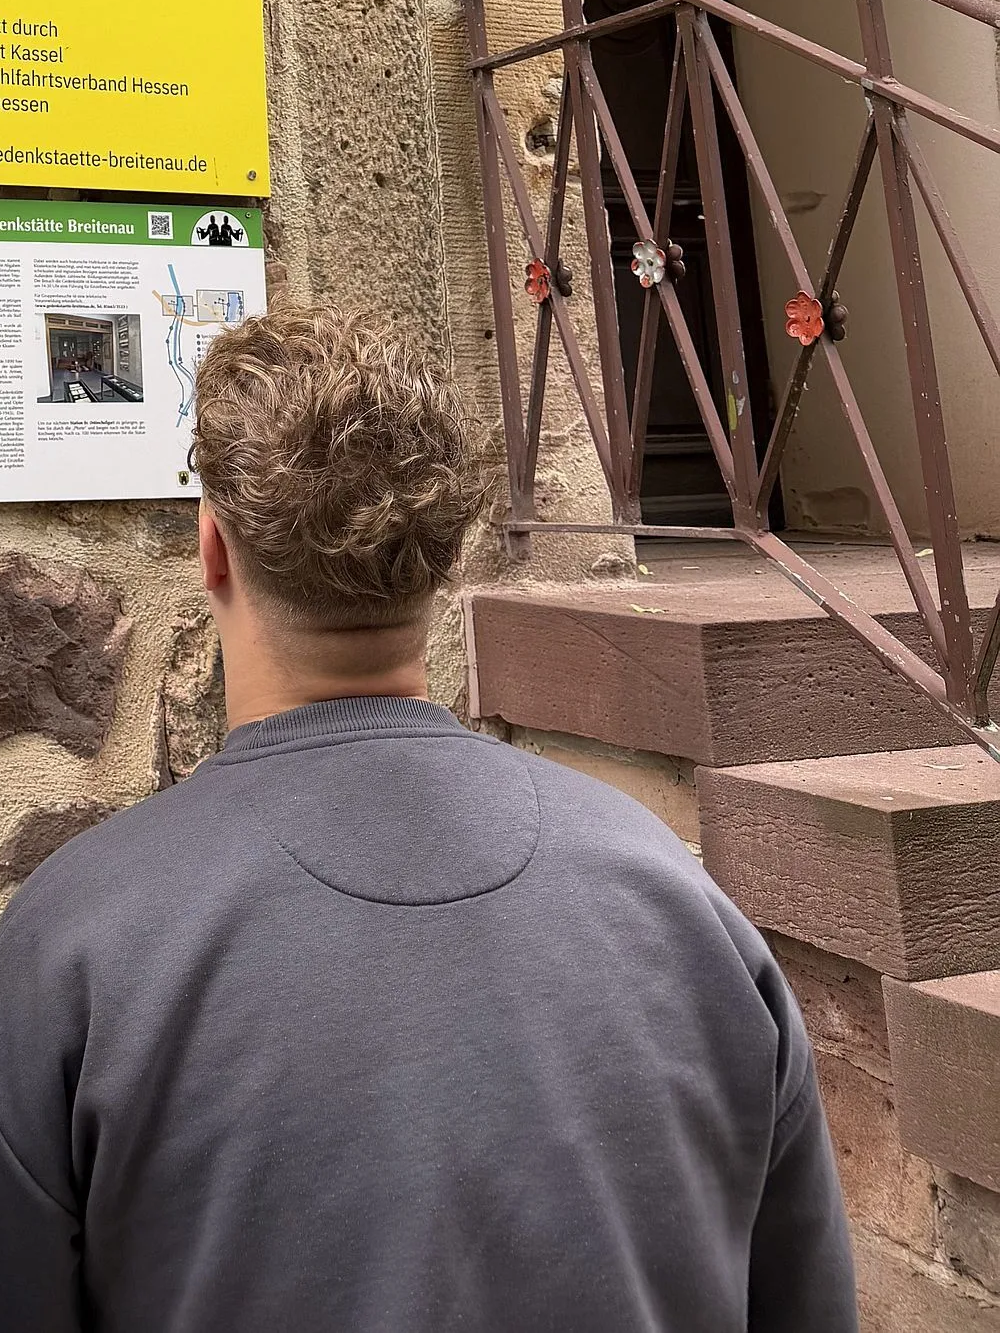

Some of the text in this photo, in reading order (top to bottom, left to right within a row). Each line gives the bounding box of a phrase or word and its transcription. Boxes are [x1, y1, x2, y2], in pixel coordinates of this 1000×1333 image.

[12, 19, 58, 37] durch
[11, 44, 63, 63] Kassel
[133, 77, 188, 96] Hessen
[68, 219, 134, 235] Breitenau
